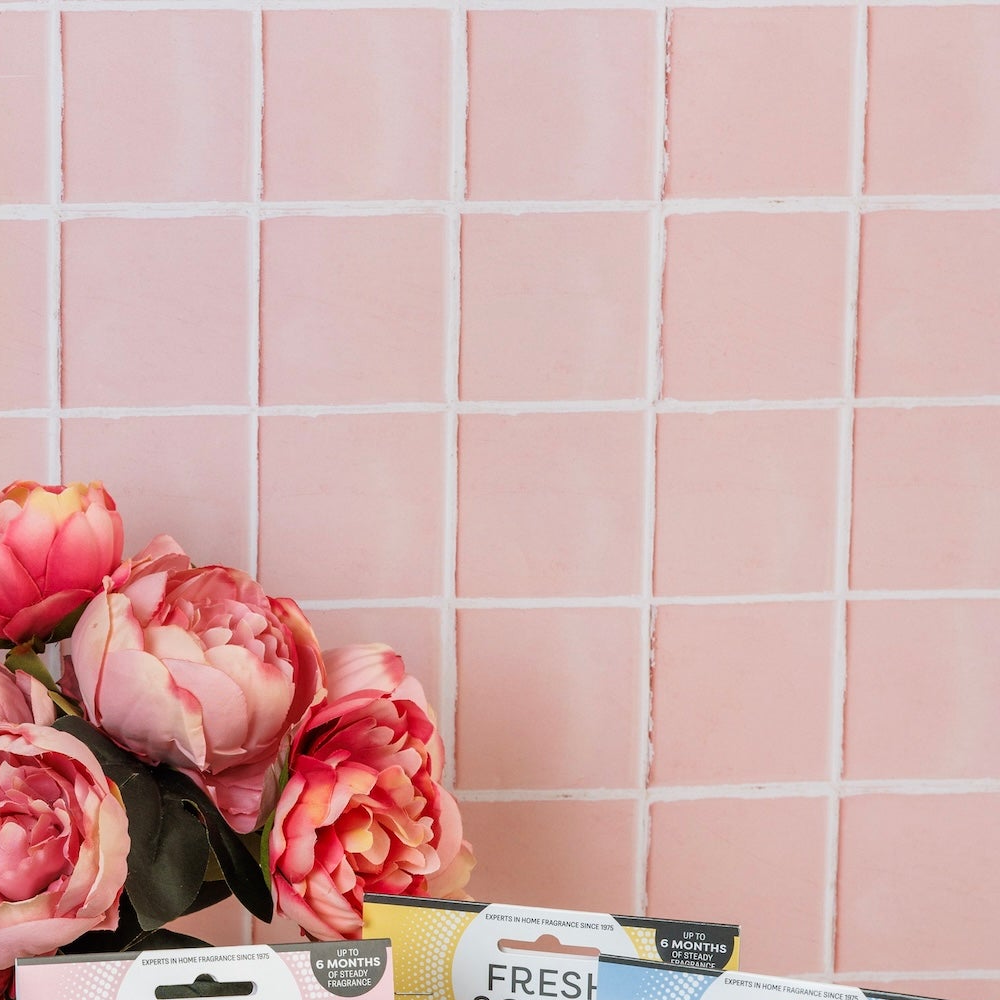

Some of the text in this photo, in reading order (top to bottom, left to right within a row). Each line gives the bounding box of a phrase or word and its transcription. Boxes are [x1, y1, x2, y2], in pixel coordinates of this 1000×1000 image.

[682, 931, 706, 941] UP TO
[660, 938, 727, 953] 6 MONTHS
[337, 949, 350, 957] UP
[671, 951, 713, 962] OF STEADY
[142, 958, 169, 966] EXPERTS
[178, 956, 198, 964] HOME
[198, 954, 235, 963] FRAGRANCE
[236, 953, 255, 961] SINCE
[316, 957, 381, 970] 6 MONTHS
[328, 970, 368, 980] OF STEADY
[327, 978, 371, 988] FRAGRANCE
[724, 978, 753, 988] EXPERTS
[753, 982, 761, 990] IN
[762, 983, 782, 992] HOME
[782, 986, 822, 997] FRAGRANCE
[823, 991, 843, 1000] SINCE
